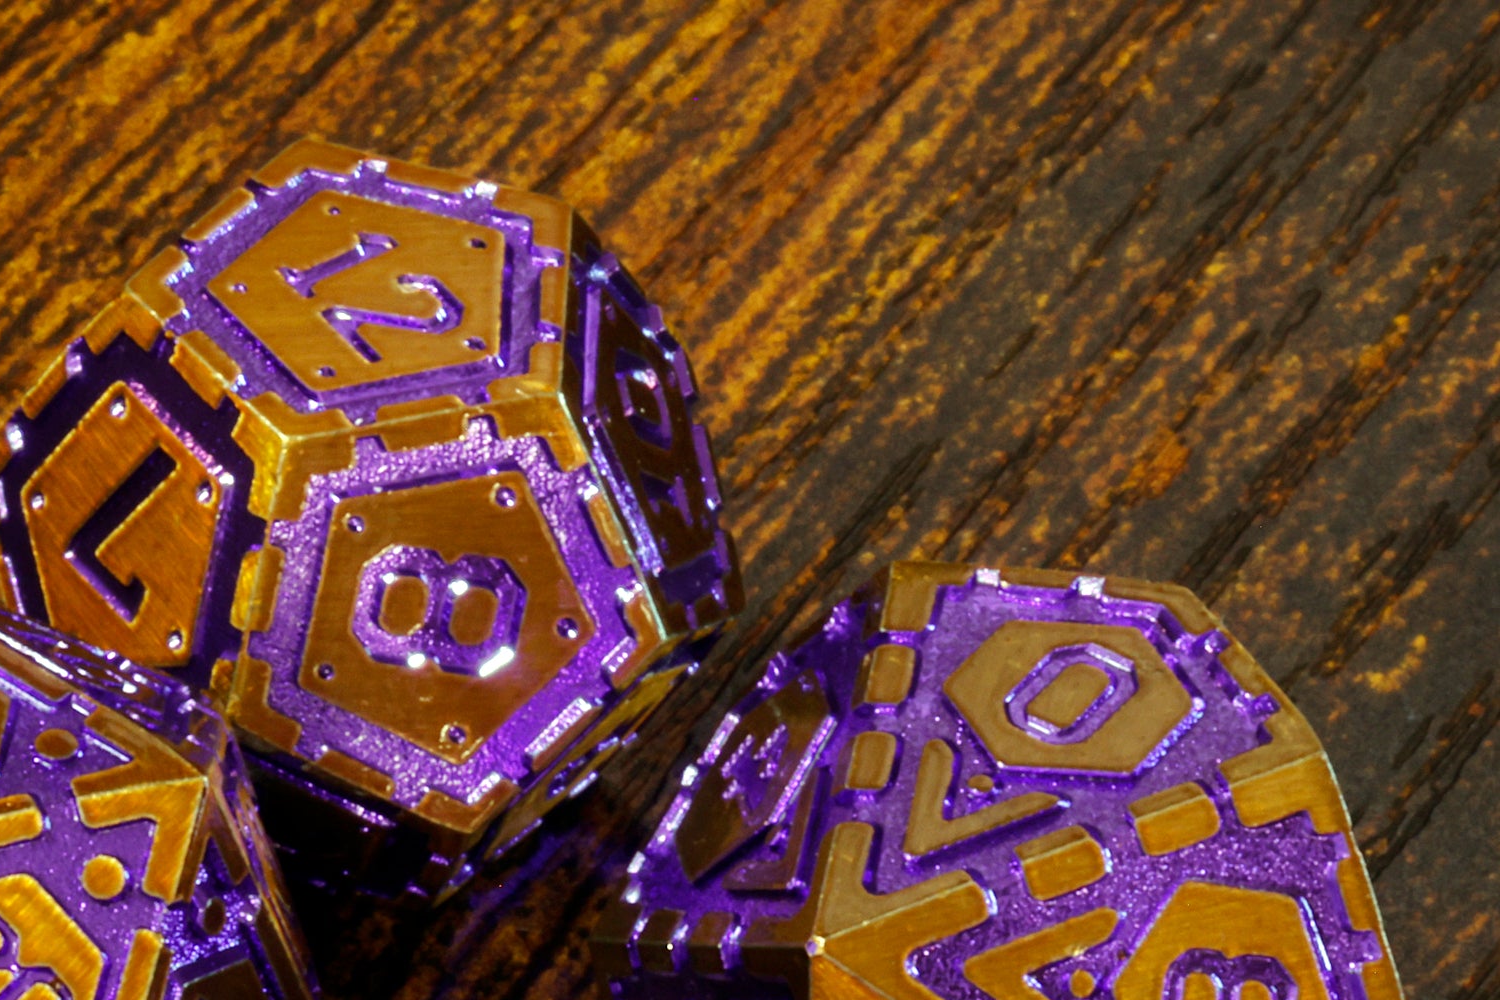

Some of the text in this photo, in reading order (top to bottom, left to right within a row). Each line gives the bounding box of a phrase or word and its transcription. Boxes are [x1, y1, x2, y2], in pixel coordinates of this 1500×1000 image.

[277, 231, 465, 364] 12
[65, 445, 177, 626] 7
[349, 543, 528, 677] 8
[1004, 642, 1137, 746] 0
